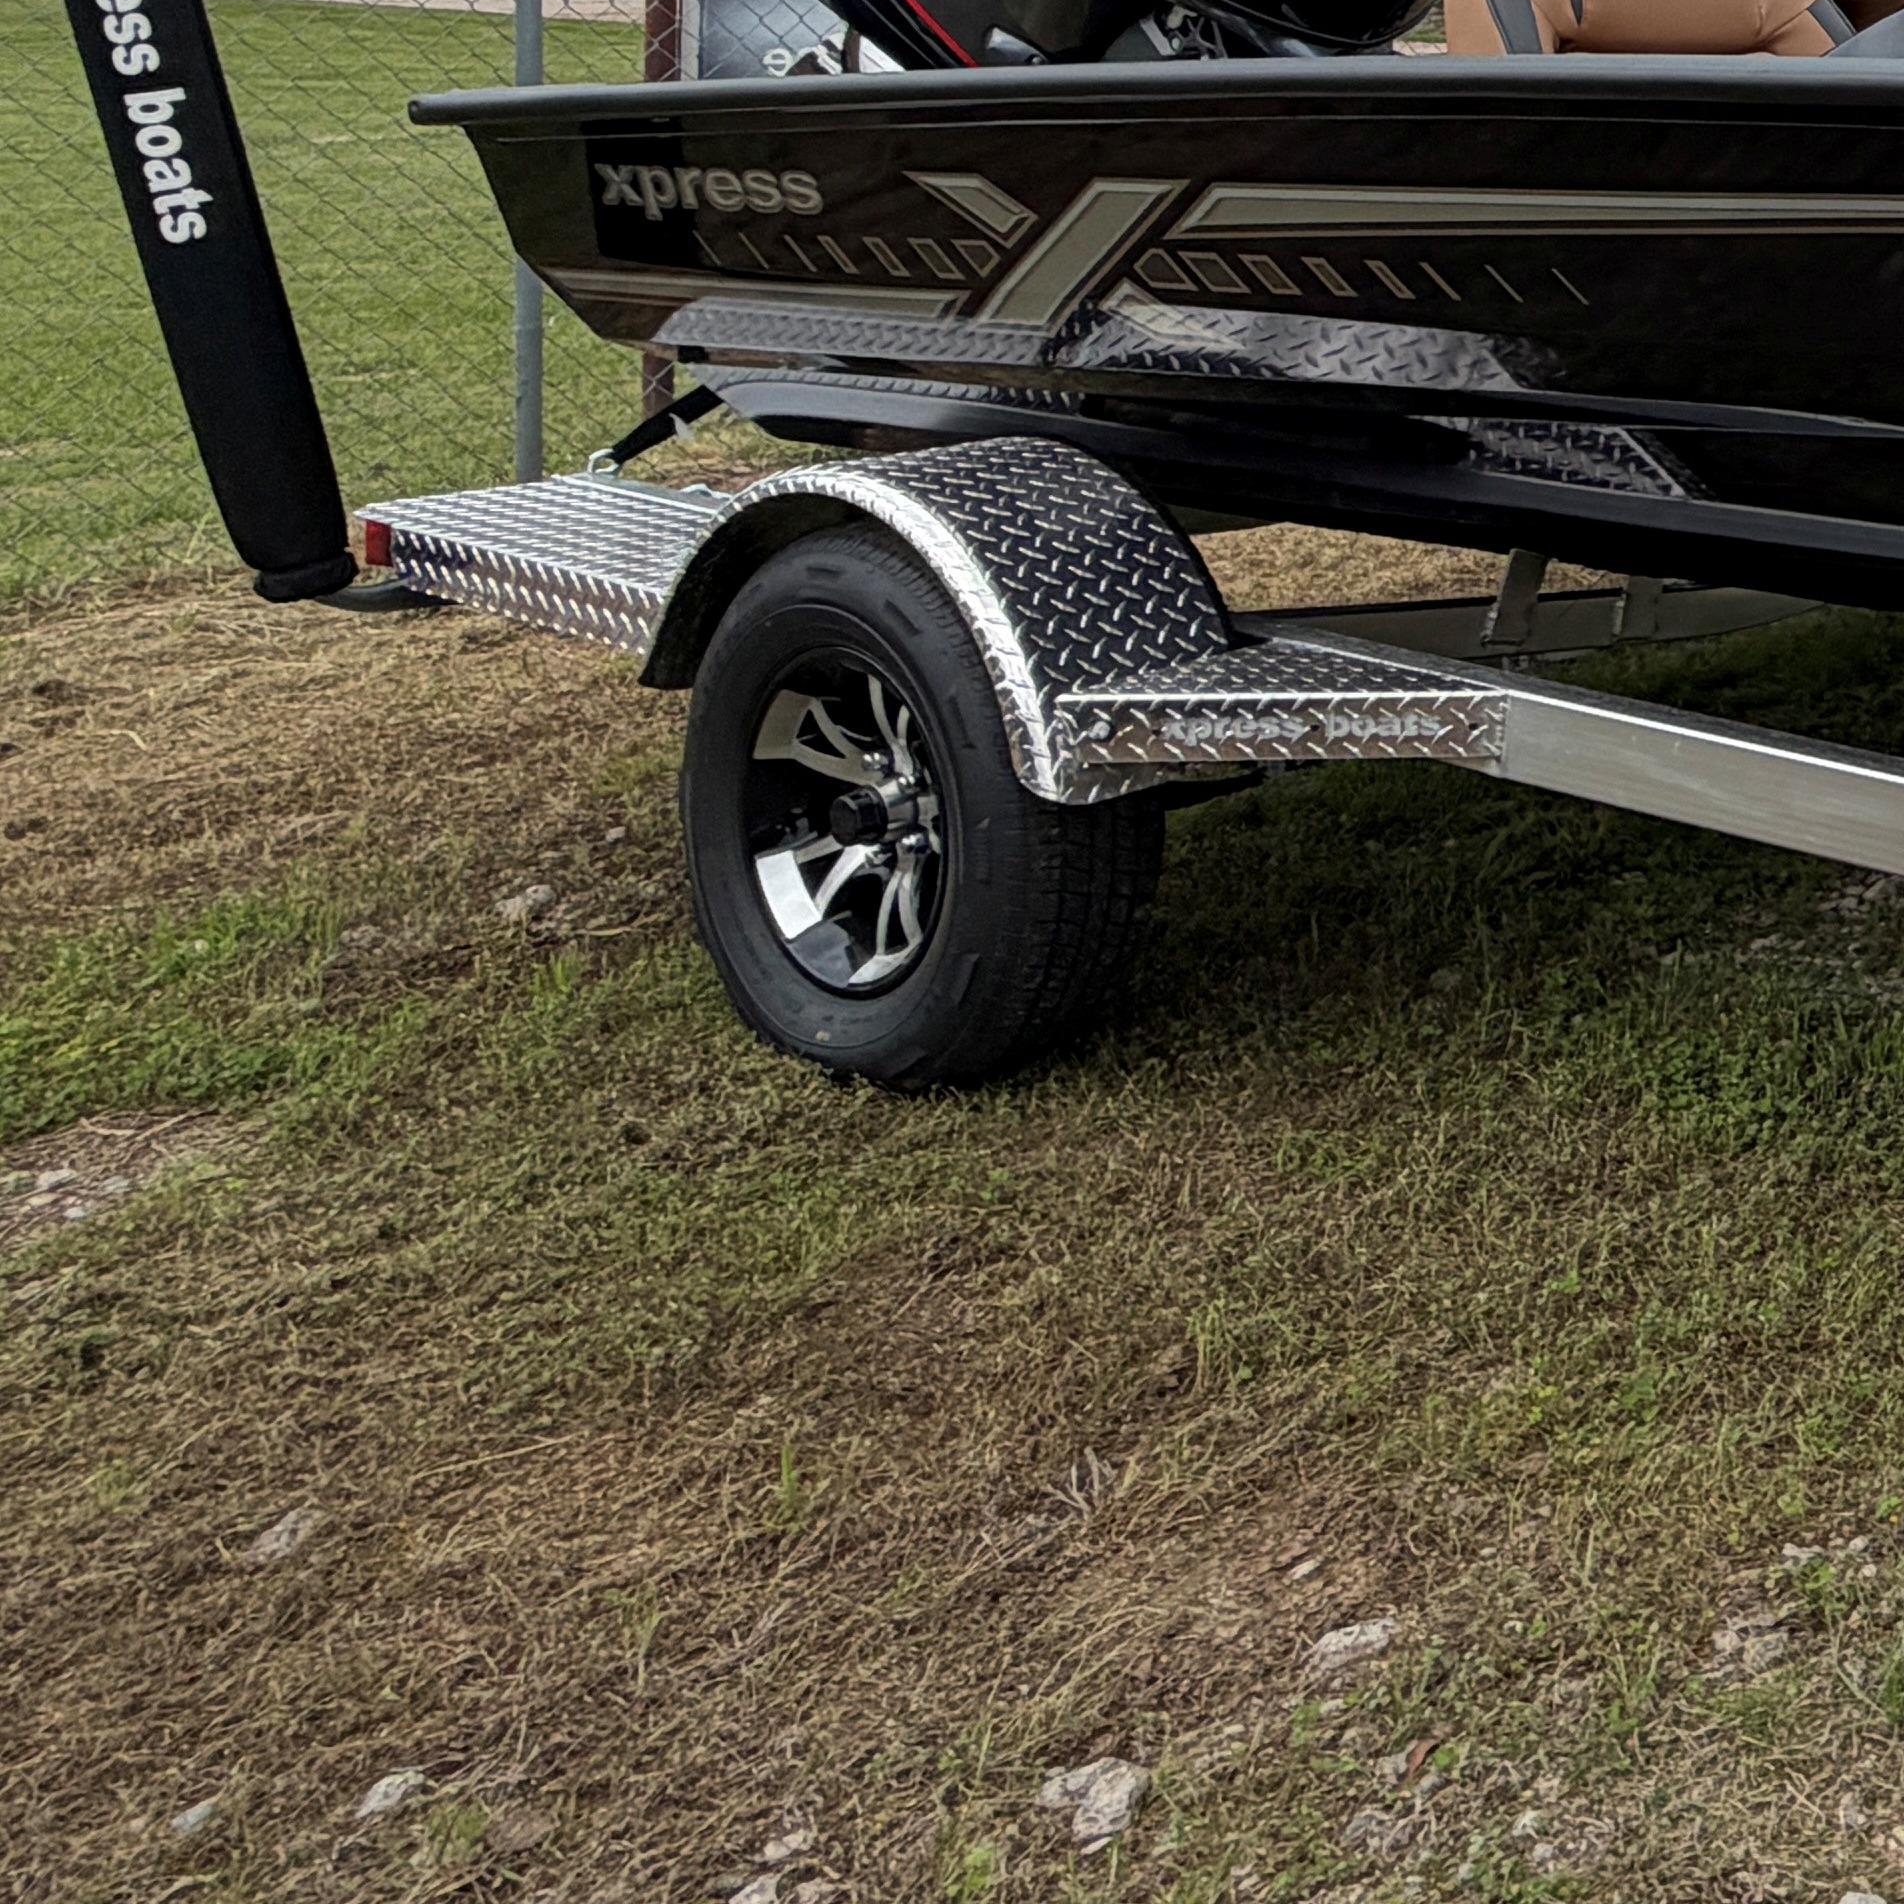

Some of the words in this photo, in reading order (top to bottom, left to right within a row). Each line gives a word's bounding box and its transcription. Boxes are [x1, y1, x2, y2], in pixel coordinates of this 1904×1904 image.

[123, 87, 214, 245] boats
[594, 163, 824, 222] xpress
[1161, 715, 1304, 746] xpress
[1324, 711, 1442, 738] boats
